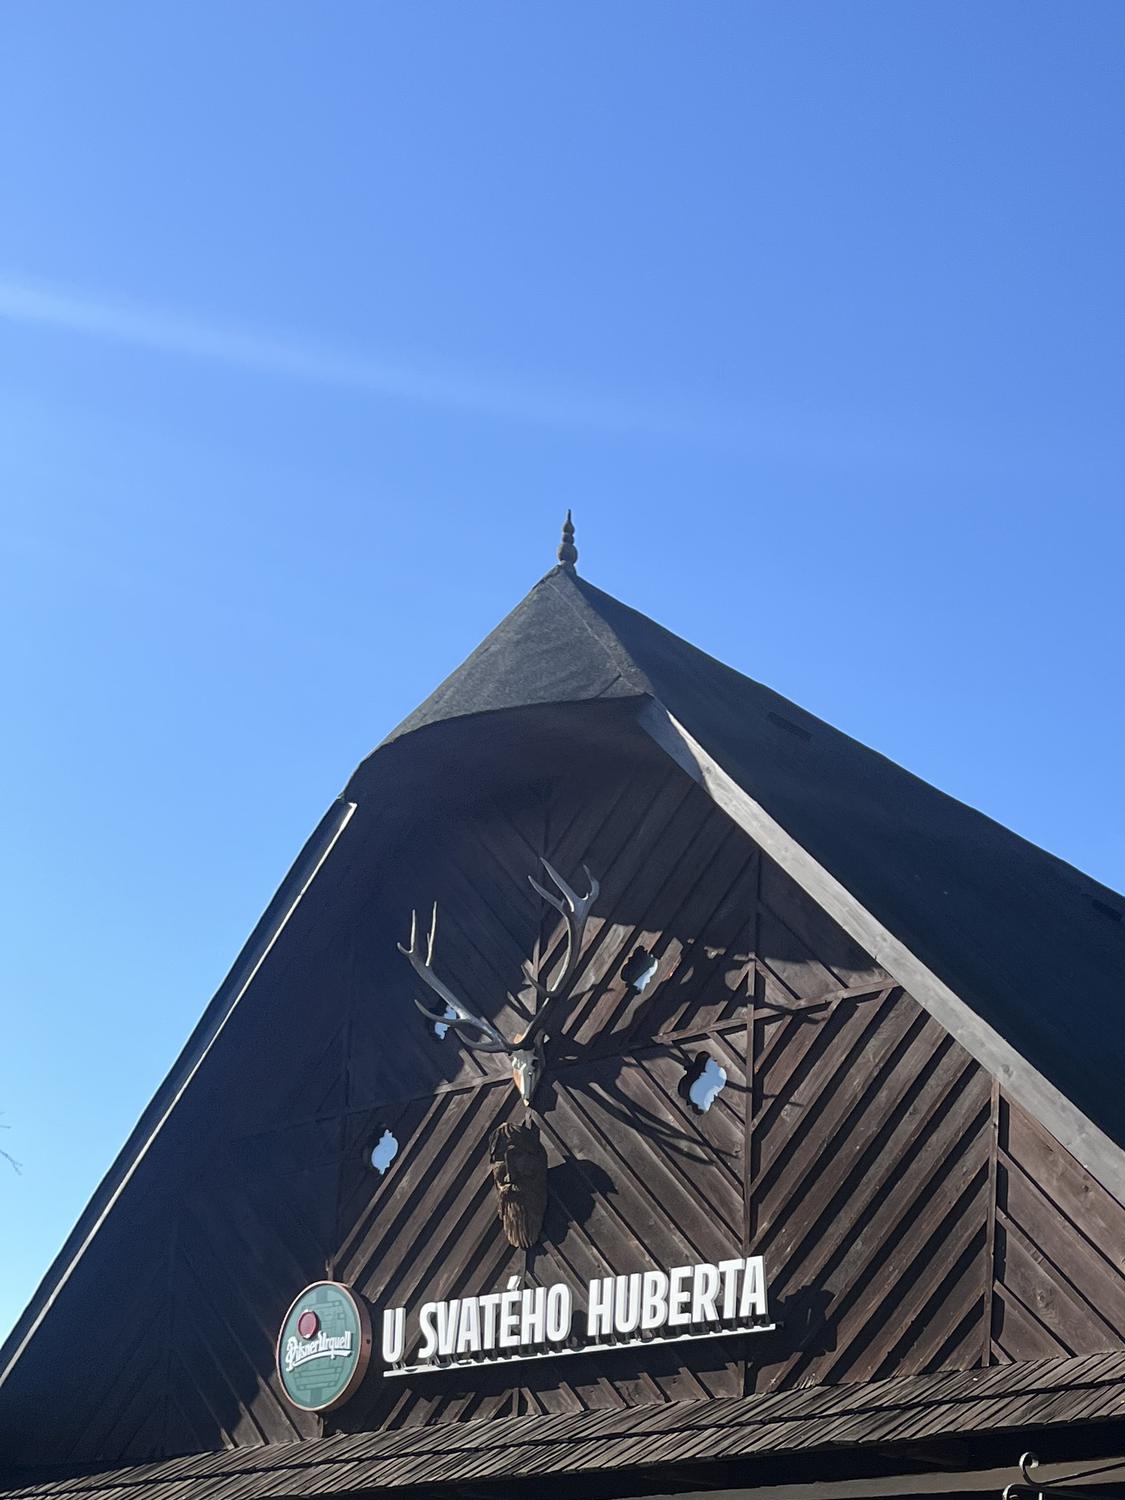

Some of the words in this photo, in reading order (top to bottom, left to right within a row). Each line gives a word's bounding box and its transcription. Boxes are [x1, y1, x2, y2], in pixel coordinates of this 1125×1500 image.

[382, 1307, 407, 1363] U
[418, 1275, 573, 1359] SVATÉHO
[587, 1255, 768, 1337] HUBERTA
[285, 1336, 319, 1371] Pilsner
[318, 1331, 352, 1359] Urquell
